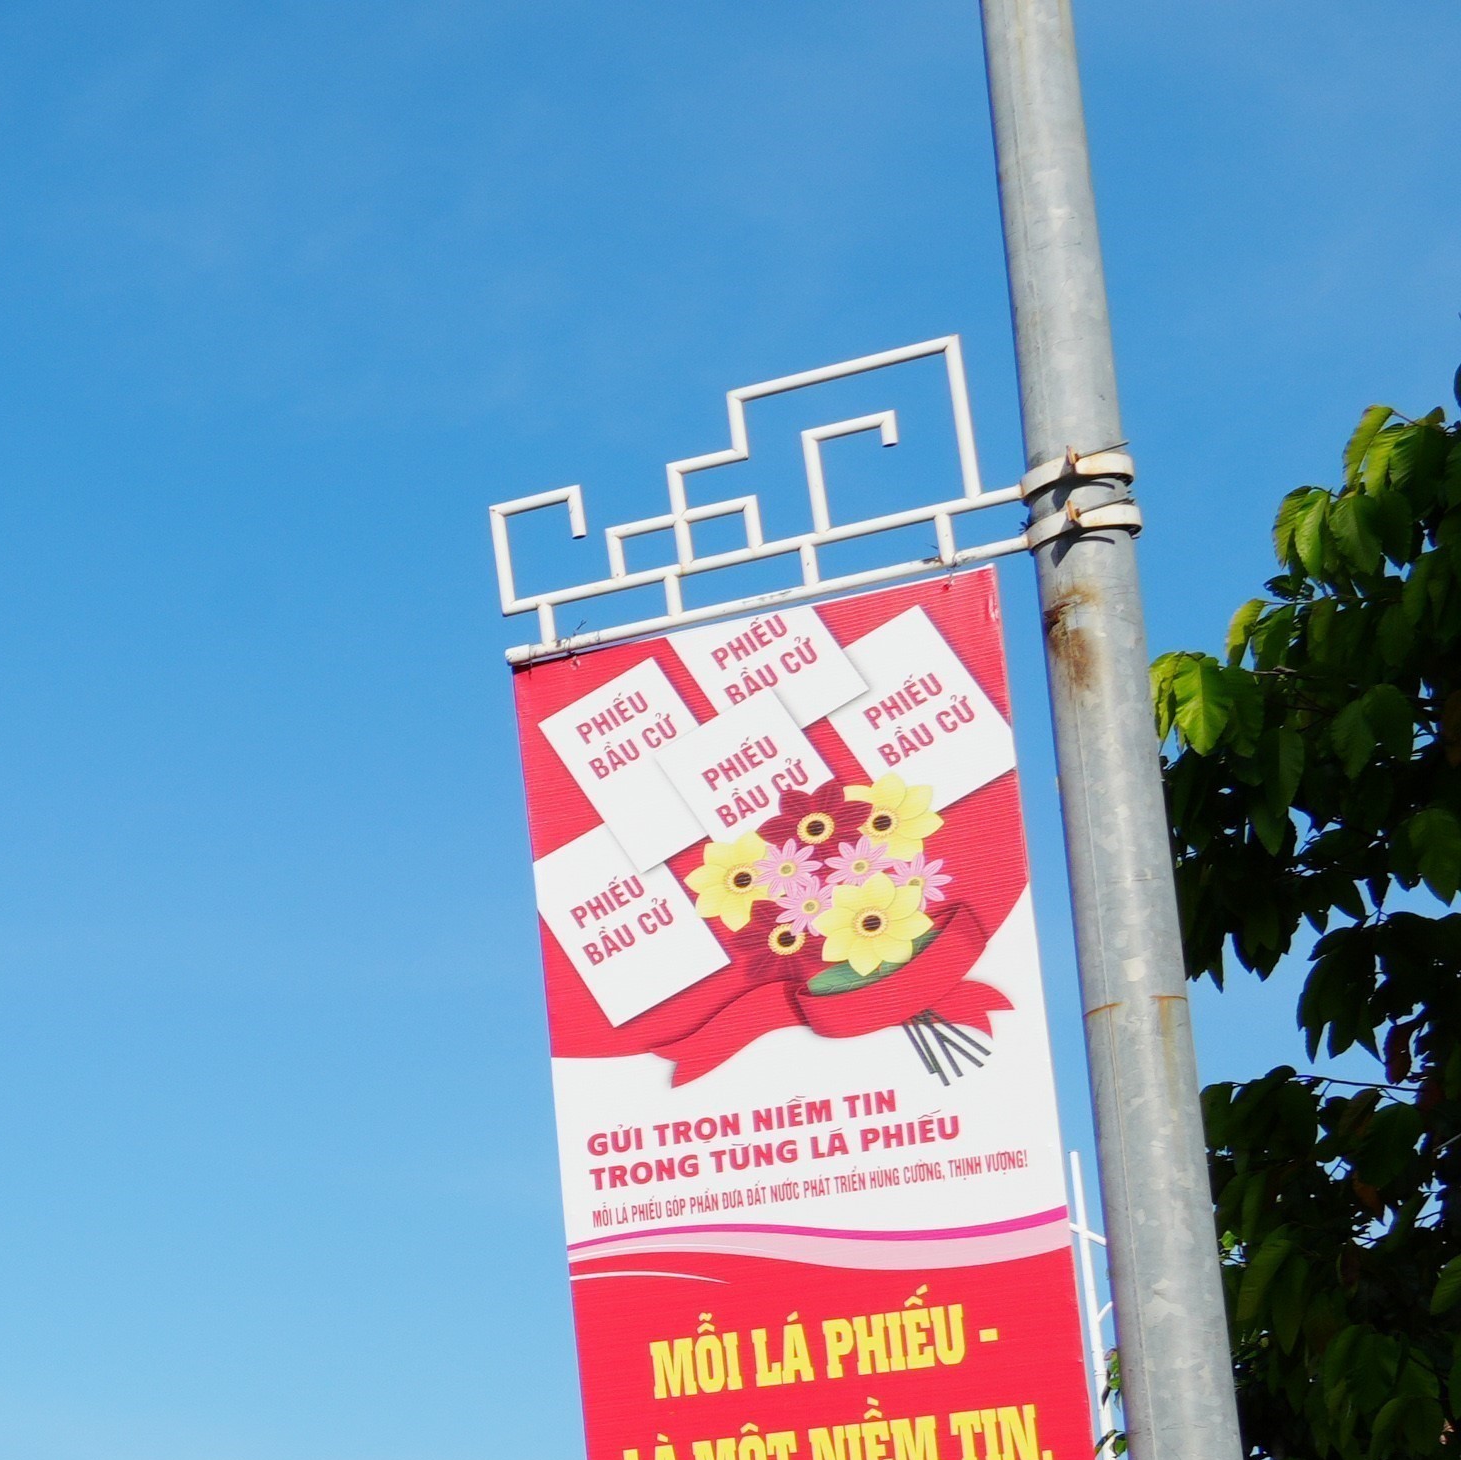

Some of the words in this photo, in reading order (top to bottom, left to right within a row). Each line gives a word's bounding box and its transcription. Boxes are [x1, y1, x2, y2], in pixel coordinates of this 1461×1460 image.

[710, 613, 788, 672] PHIẾU
[723, 667, 777, 704] BẦU
[780, 636, 820, 676] CỬ
[575, 690, 649, 745] PHIẾU
[863, 672, 943, 730] PHIẾU
[877, 724, 934, 767] BẦU
[938, 695, 977, 735] CỬ
[587, 741, 639, 781] BẦU
[640, 713, 679, 753] CỬ
[701, 735, 778, 792] PHIẾU
[715, 787, 766, 829] BẦU
[775, 758, 810, 796] CỬ
[569, 870, 645, 930] PHIẾU
[582, 925, 635, 967] BẦU
[641, 898, 674, 937] CỬ
[587, 1124, 643, 1157] GỬI
[653, 1113, 740, 1145] TRỌN
[752, 1095, 833, 1131] NIỀM
[843, 1088, 897, 1118] TIN
[589, 1154, 700, 1191] TRONG
[709, 1139, 798, 1174] TỪNG
[810, 1126, 849, 1159] LÁ
[860, 1109, 961, 1152] PHIẾU
[592, 1203, 613, 1228] MỖI
[616, 1202, 629, 1223] LÁ
[632, 1194, 662, 1222] PHIẾU
[666, 1194, 686, 1218] GÓP
[689, 1188, 719, 1215] PHẦN
[722, 1188, 744, 1211] ĐƯA
[746, 1180, 767, 1207] ĐẤT
[771, 1177, 800, 1203] NƯỚC
[803, 1172, 831, 1198] PHÁT
[833, 1163, 866, 1194] TRIỂN
[869, 1163, 900, 1189] HÙNG
[903, 1159, 946, 1185] CƯỜNG,
[948, 1156, 982, 1181] THỊNH
[985, 1149, 1029, 1176] VƯỢNG!
[649, 1311, 741, 1400] MỖI
[751, 1310, 815, 1388] LÁ
[822, 1284, 966, 1379] PHIẾU
